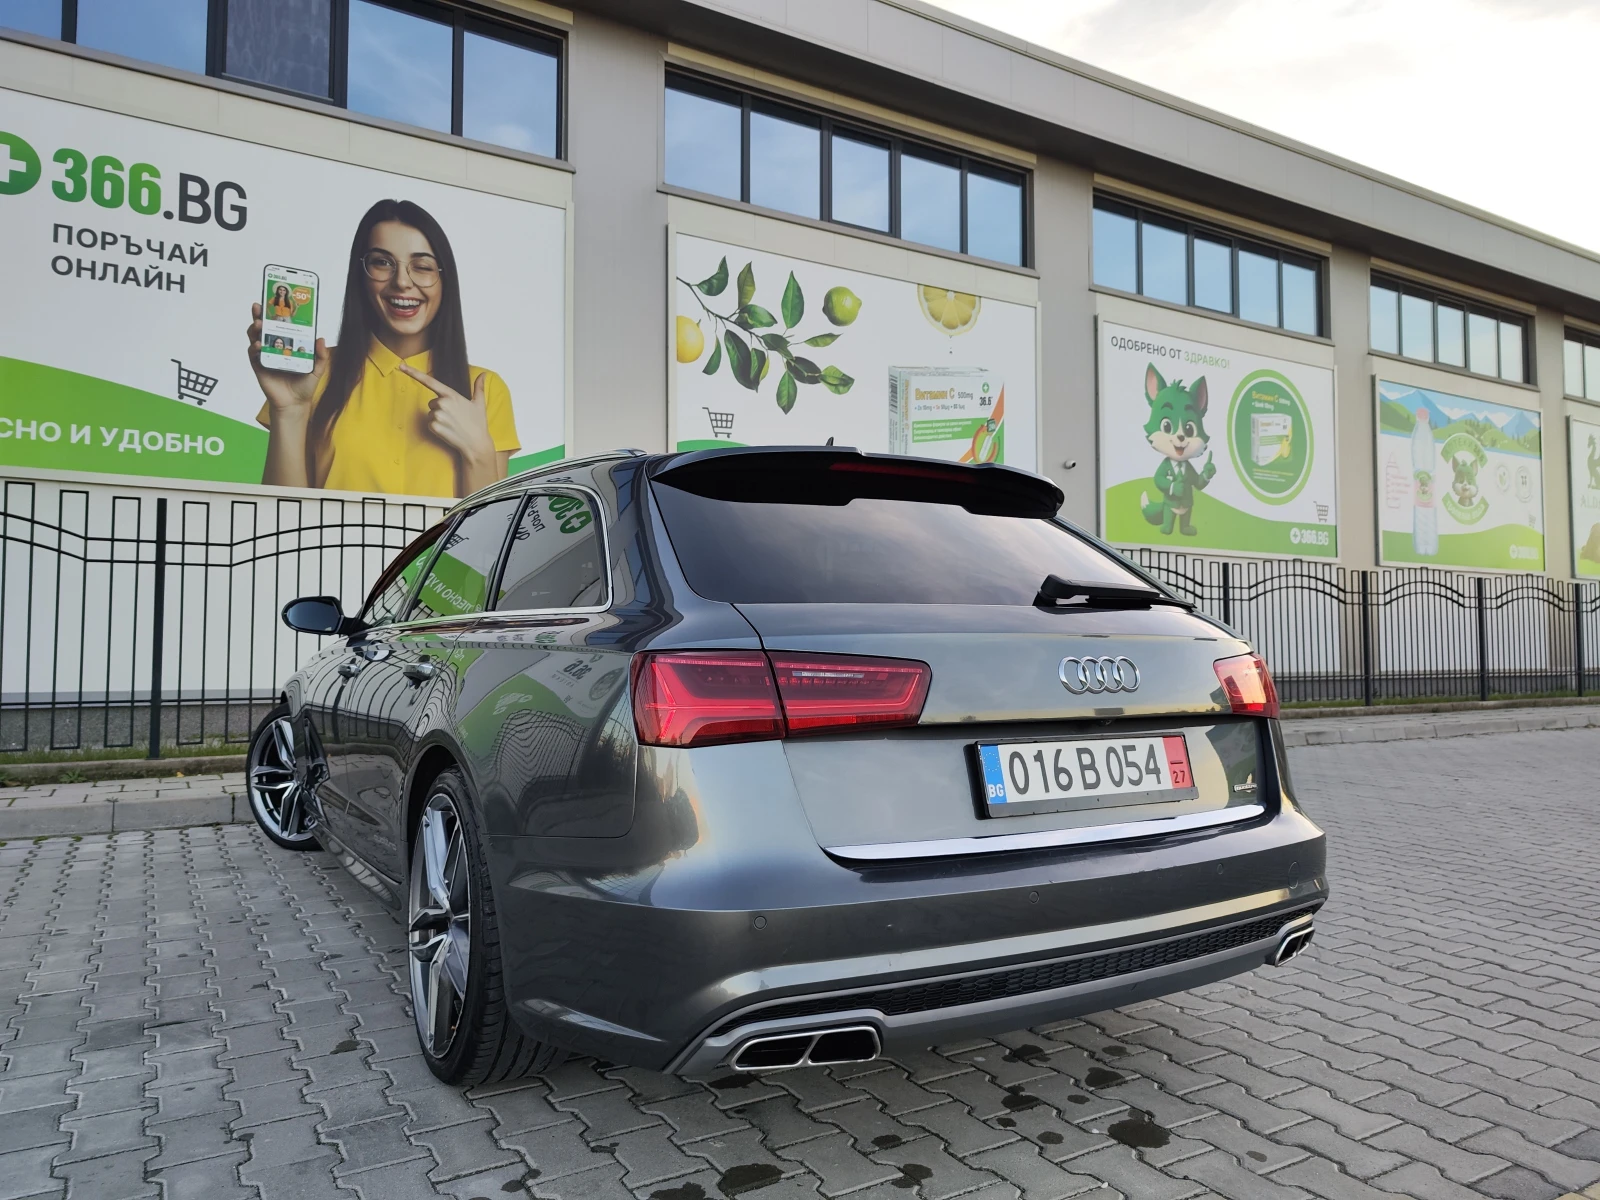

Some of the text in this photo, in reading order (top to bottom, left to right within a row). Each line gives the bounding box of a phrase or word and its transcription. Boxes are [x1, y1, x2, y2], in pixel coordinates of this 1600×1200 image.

[51, 148, 248, 231] 366.BG
[52, 223, 209, 267] ПОРЪЧАЙ
[51, 255, 186, 293] ОНЛАЙН
[1111, 335, 1230, 369] ОДОБРЕНО ОТ ЗДРАВКО!
[70, 424, 91, 445] И
[100, 427, 225, 456] УДОБНО
[1301, 529, 1329, 546] 366.BG
[987, 783, 1004, 798] BG
[1172, 770, 1186, 784] 27
